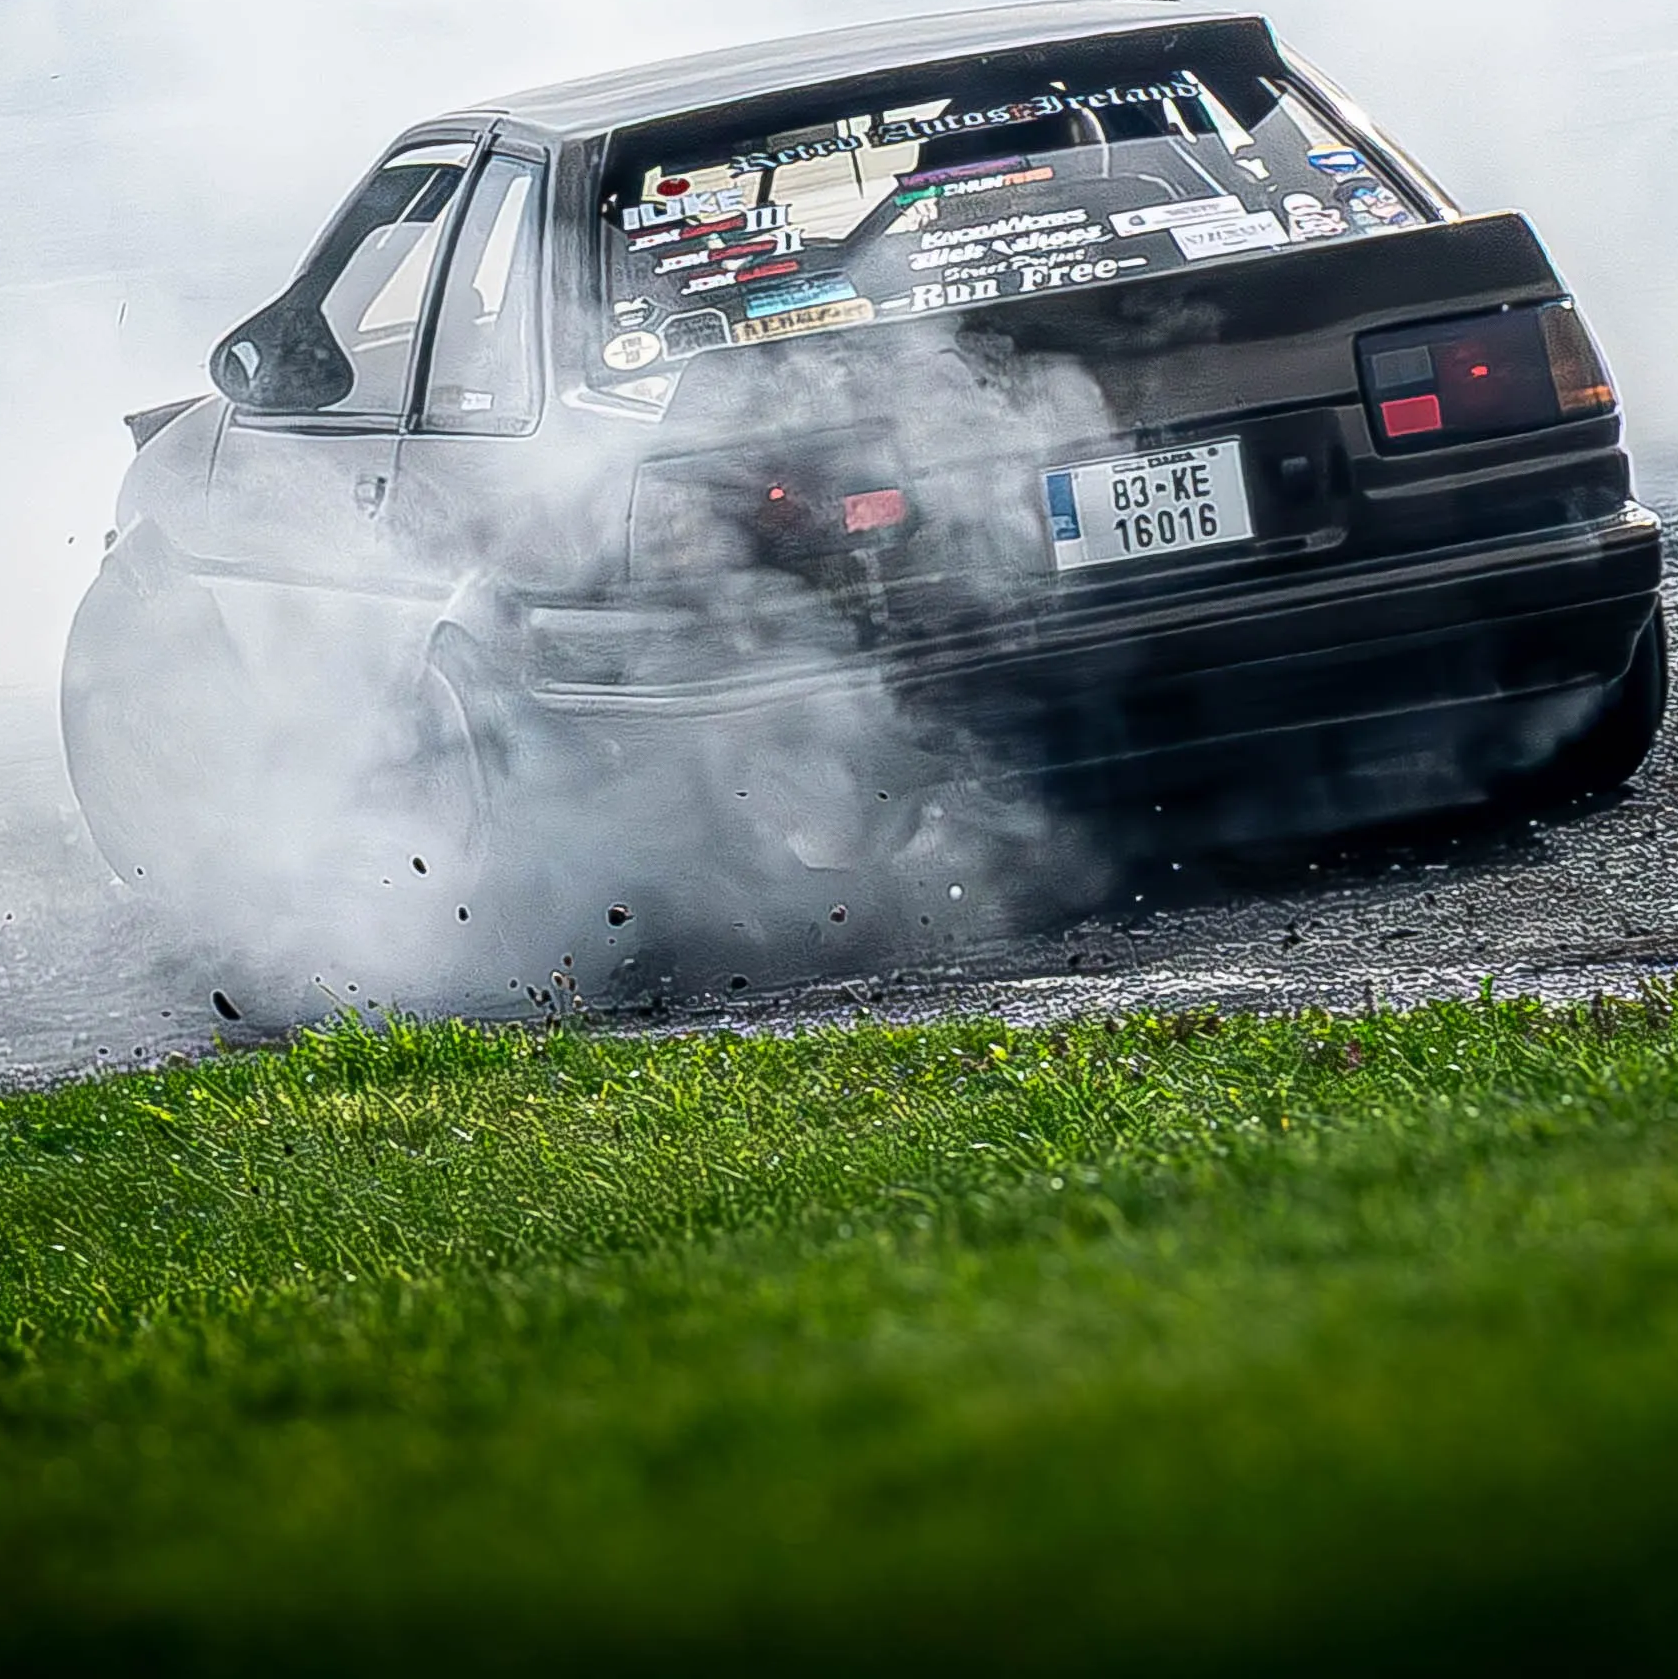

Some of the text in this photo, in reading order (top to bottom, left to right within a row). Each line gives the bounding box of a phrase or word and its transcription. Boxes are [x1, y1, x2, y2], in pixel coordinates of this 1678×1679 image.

[910, 258, 1120, 312] Run Free
[1112, 464, 1212, 511] 83-KE
[1113, 503, 1218, 553] 16016
